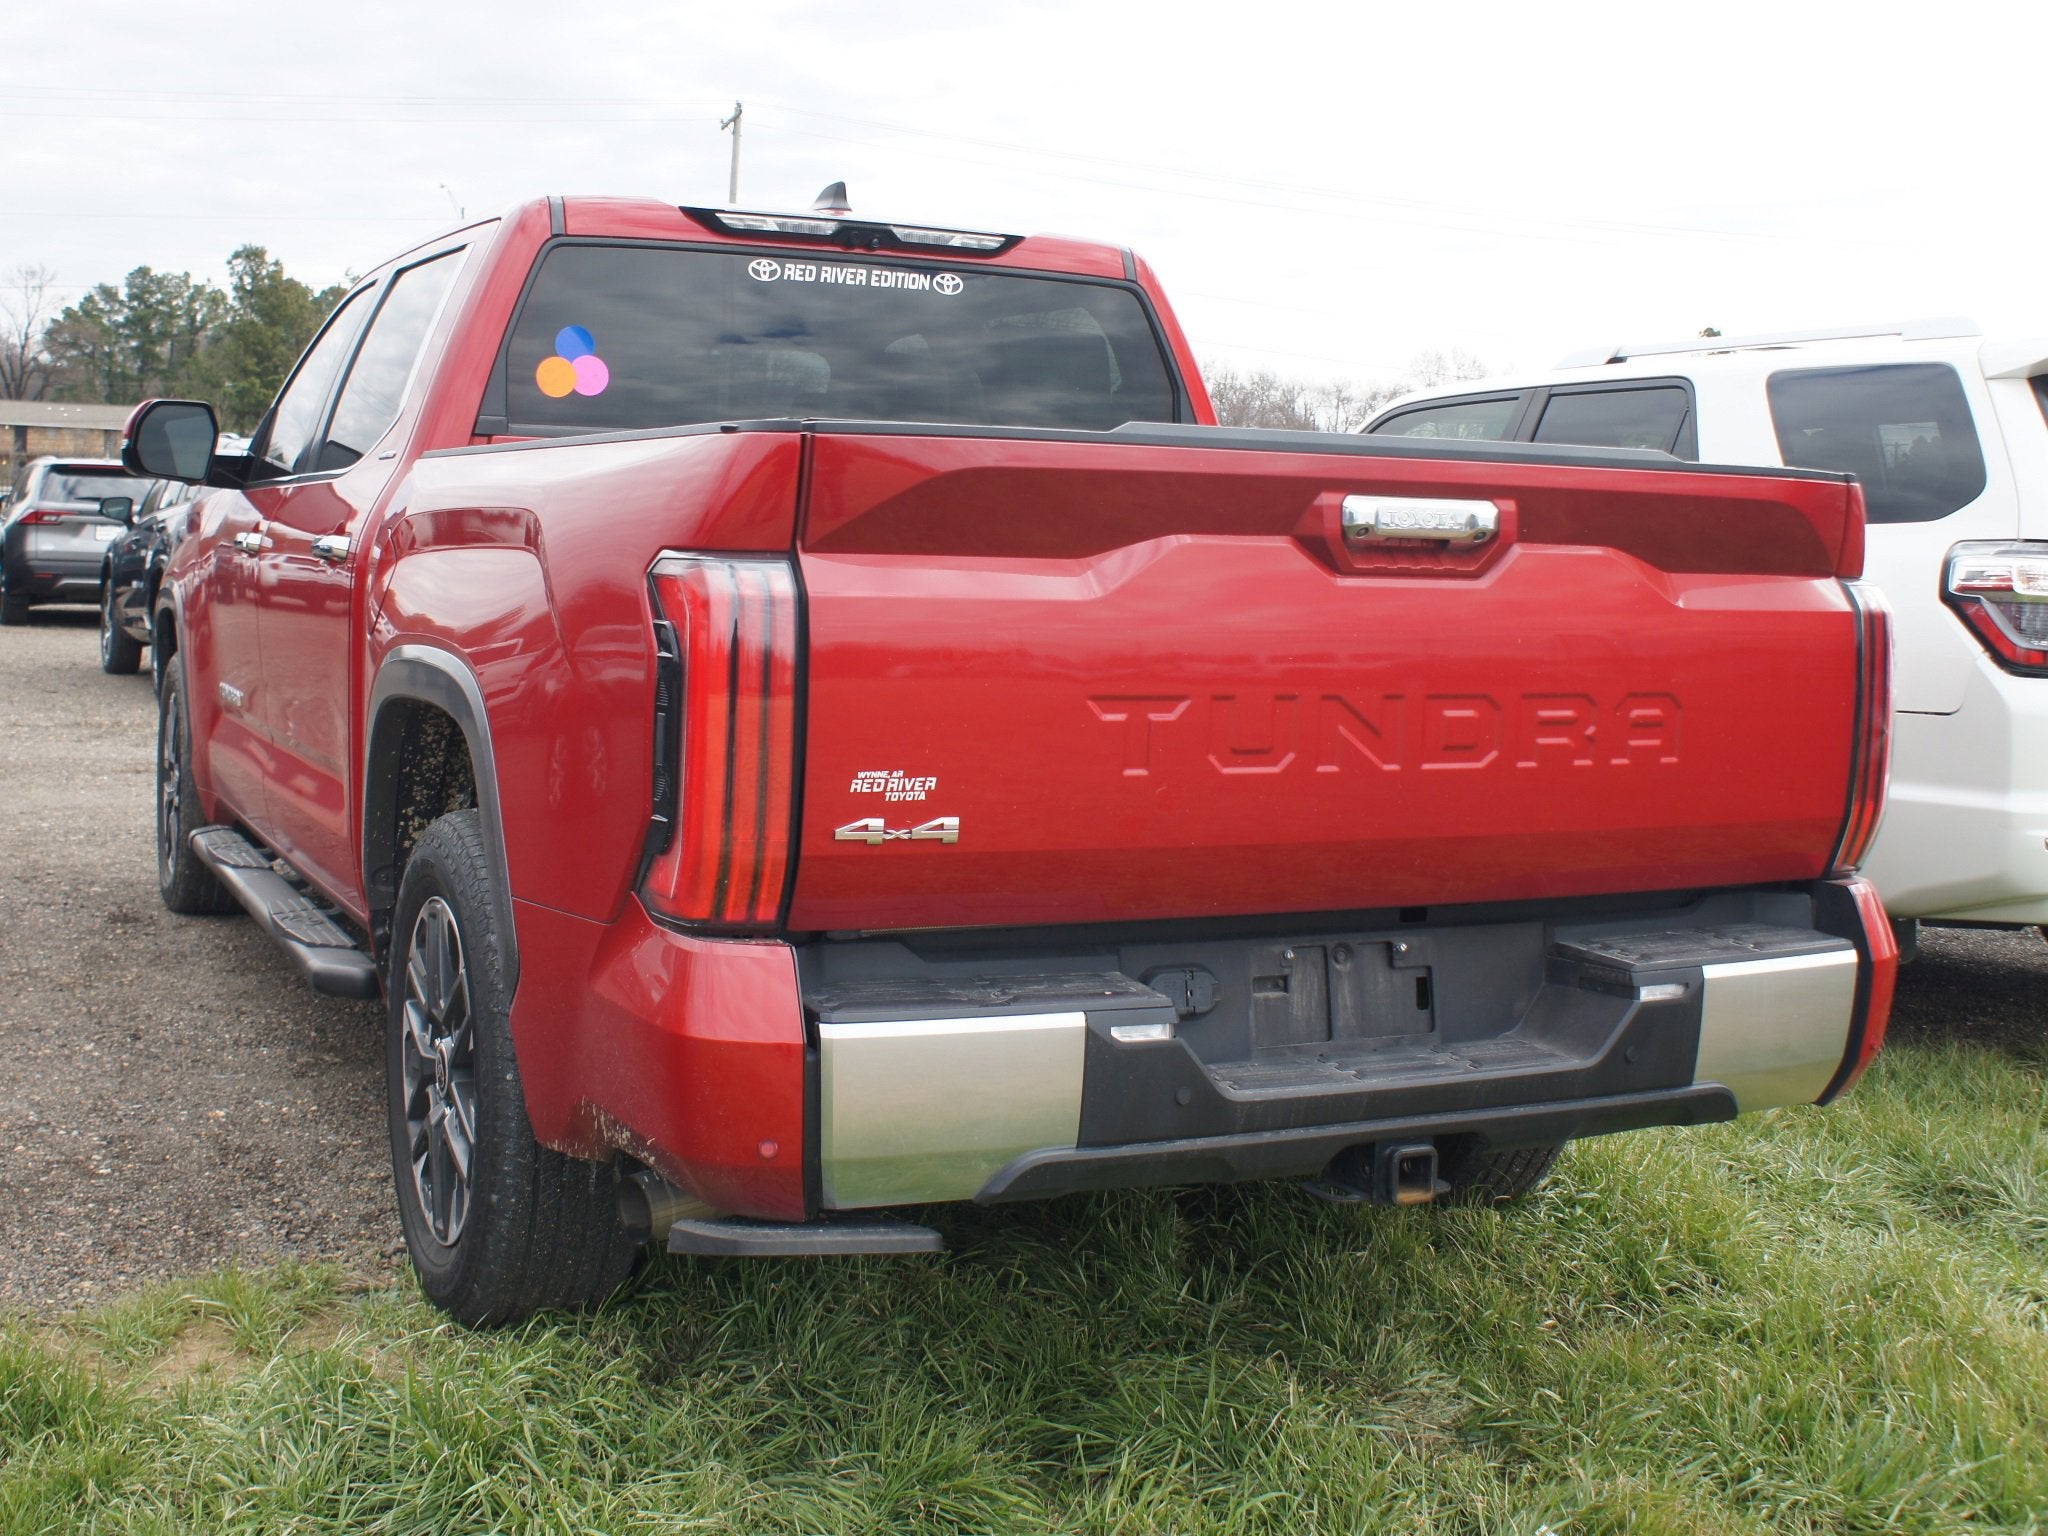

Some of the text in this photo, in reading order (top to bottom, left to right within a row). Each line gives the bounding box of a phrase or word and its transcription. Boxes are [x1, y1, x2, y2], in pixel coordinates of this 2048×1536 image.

[784, 263, 931, 290] RED RIVER EDITION
[1386, 510, 1458, 528] TOYOTA
[1086, 692, 1683, 776] TUNDRA
[857, 770, 904, 779] WYNNE, AR
[850, 777, 937, 792] RED RIVER
[885, 792, 926, 801] TOYOTA
